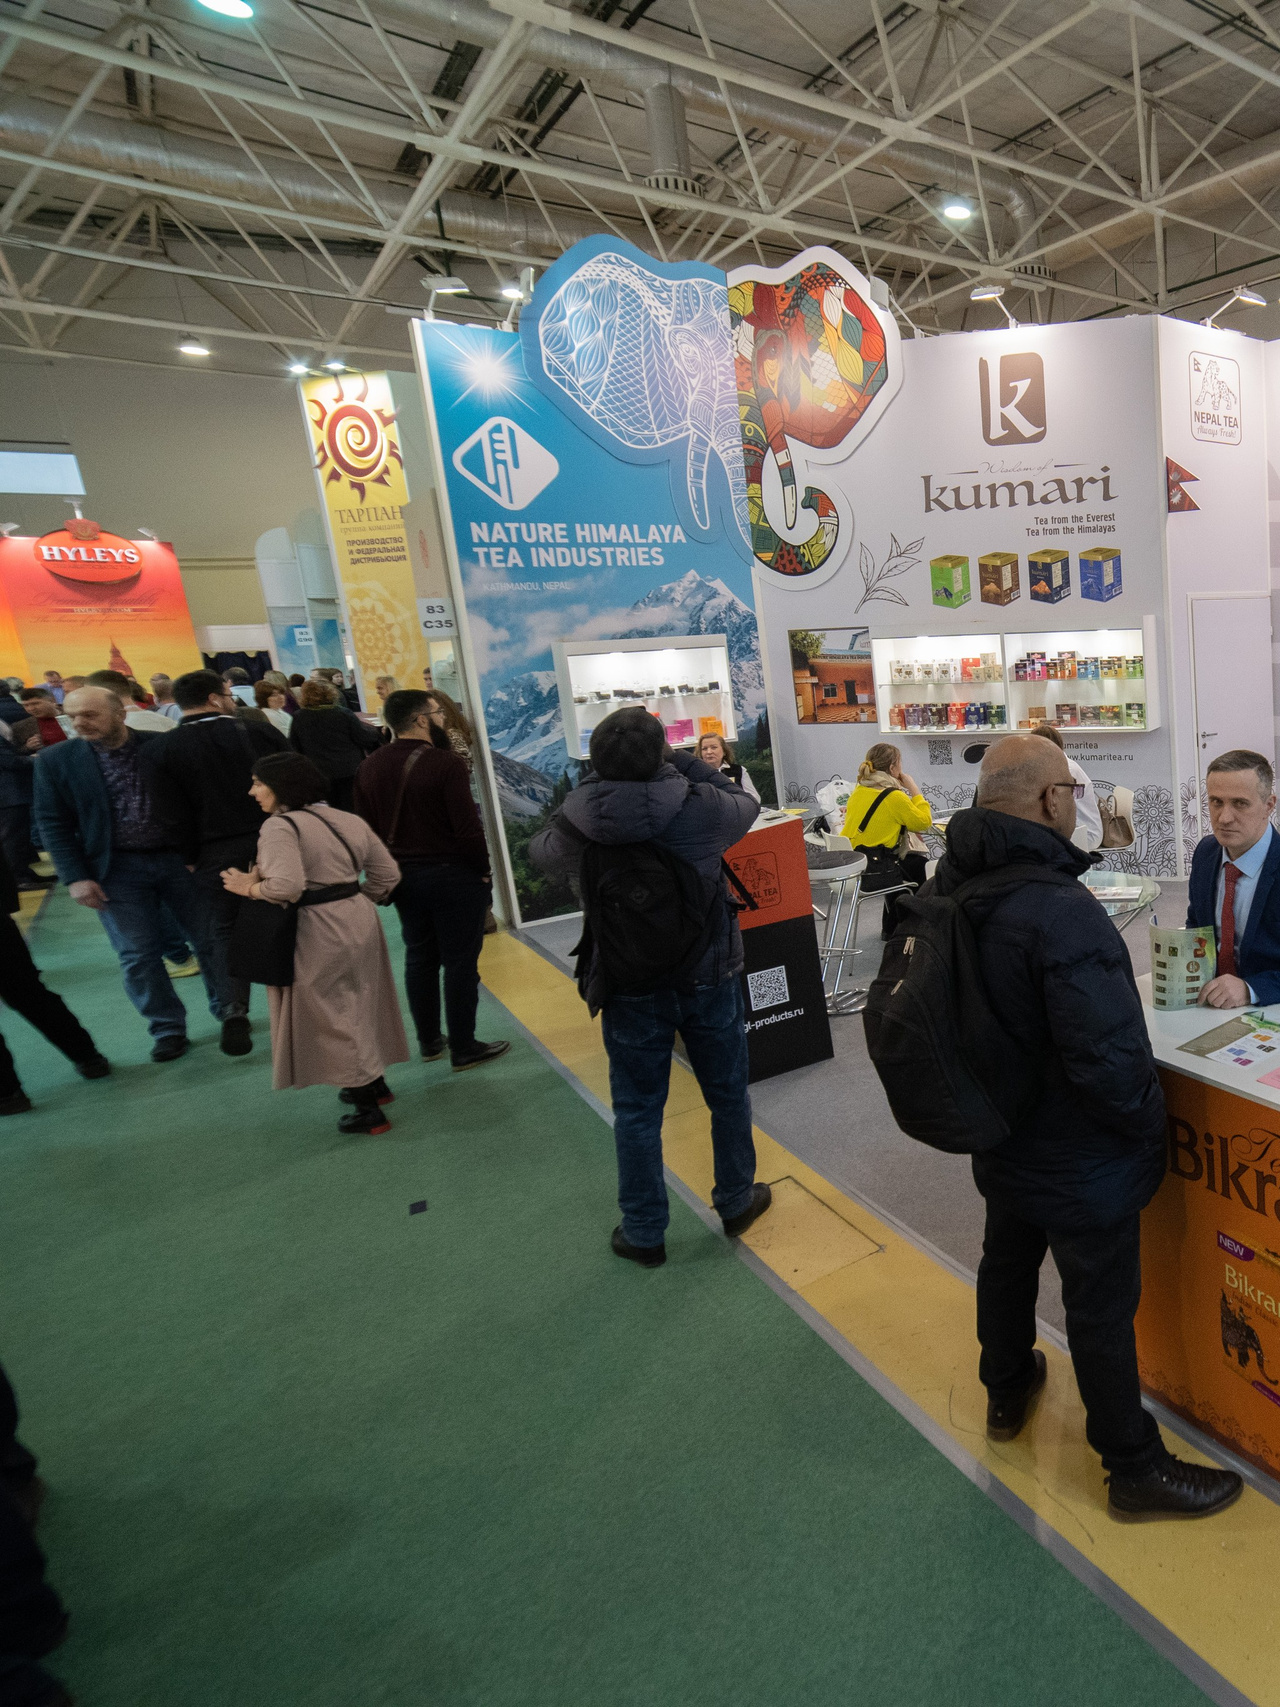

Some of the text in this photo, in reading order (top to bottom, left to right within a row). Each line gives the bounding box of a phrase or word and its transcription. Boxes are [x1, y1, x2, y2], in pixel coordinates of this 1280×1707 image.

[1194, 411, 1239, 428] NEPAL TEA
[979, 460, 1033, 474] Wisdom
[921, 465, 1119, 513] kumari
[335, 505, 404, 524] ТАРПАН
[1034, 513, 1116, 525] Tea from the Everest
[470, 522, 687, 543] NATURE HIMALAYA
[1026, 524, 1116, 537] Tea from the Himalayas
[346, 536, 404, 546] ПРОИЗВОДСТВО
[38, 545, 140, 563] HYLEYS
[355, 546, 406, 555] ФЕДЕРАЛЬНАЯ
[472, 547, 665, 568] TEA INDUSTRIES
[483, 581, 571, 591] KATHMANDU, NEPAL
[426, 605, 445, 614] 83
[423, 620, 454, 629] C35
[763, 888, 778, 897] TEA
[1219, 1234, 1245, 1257] NEW
